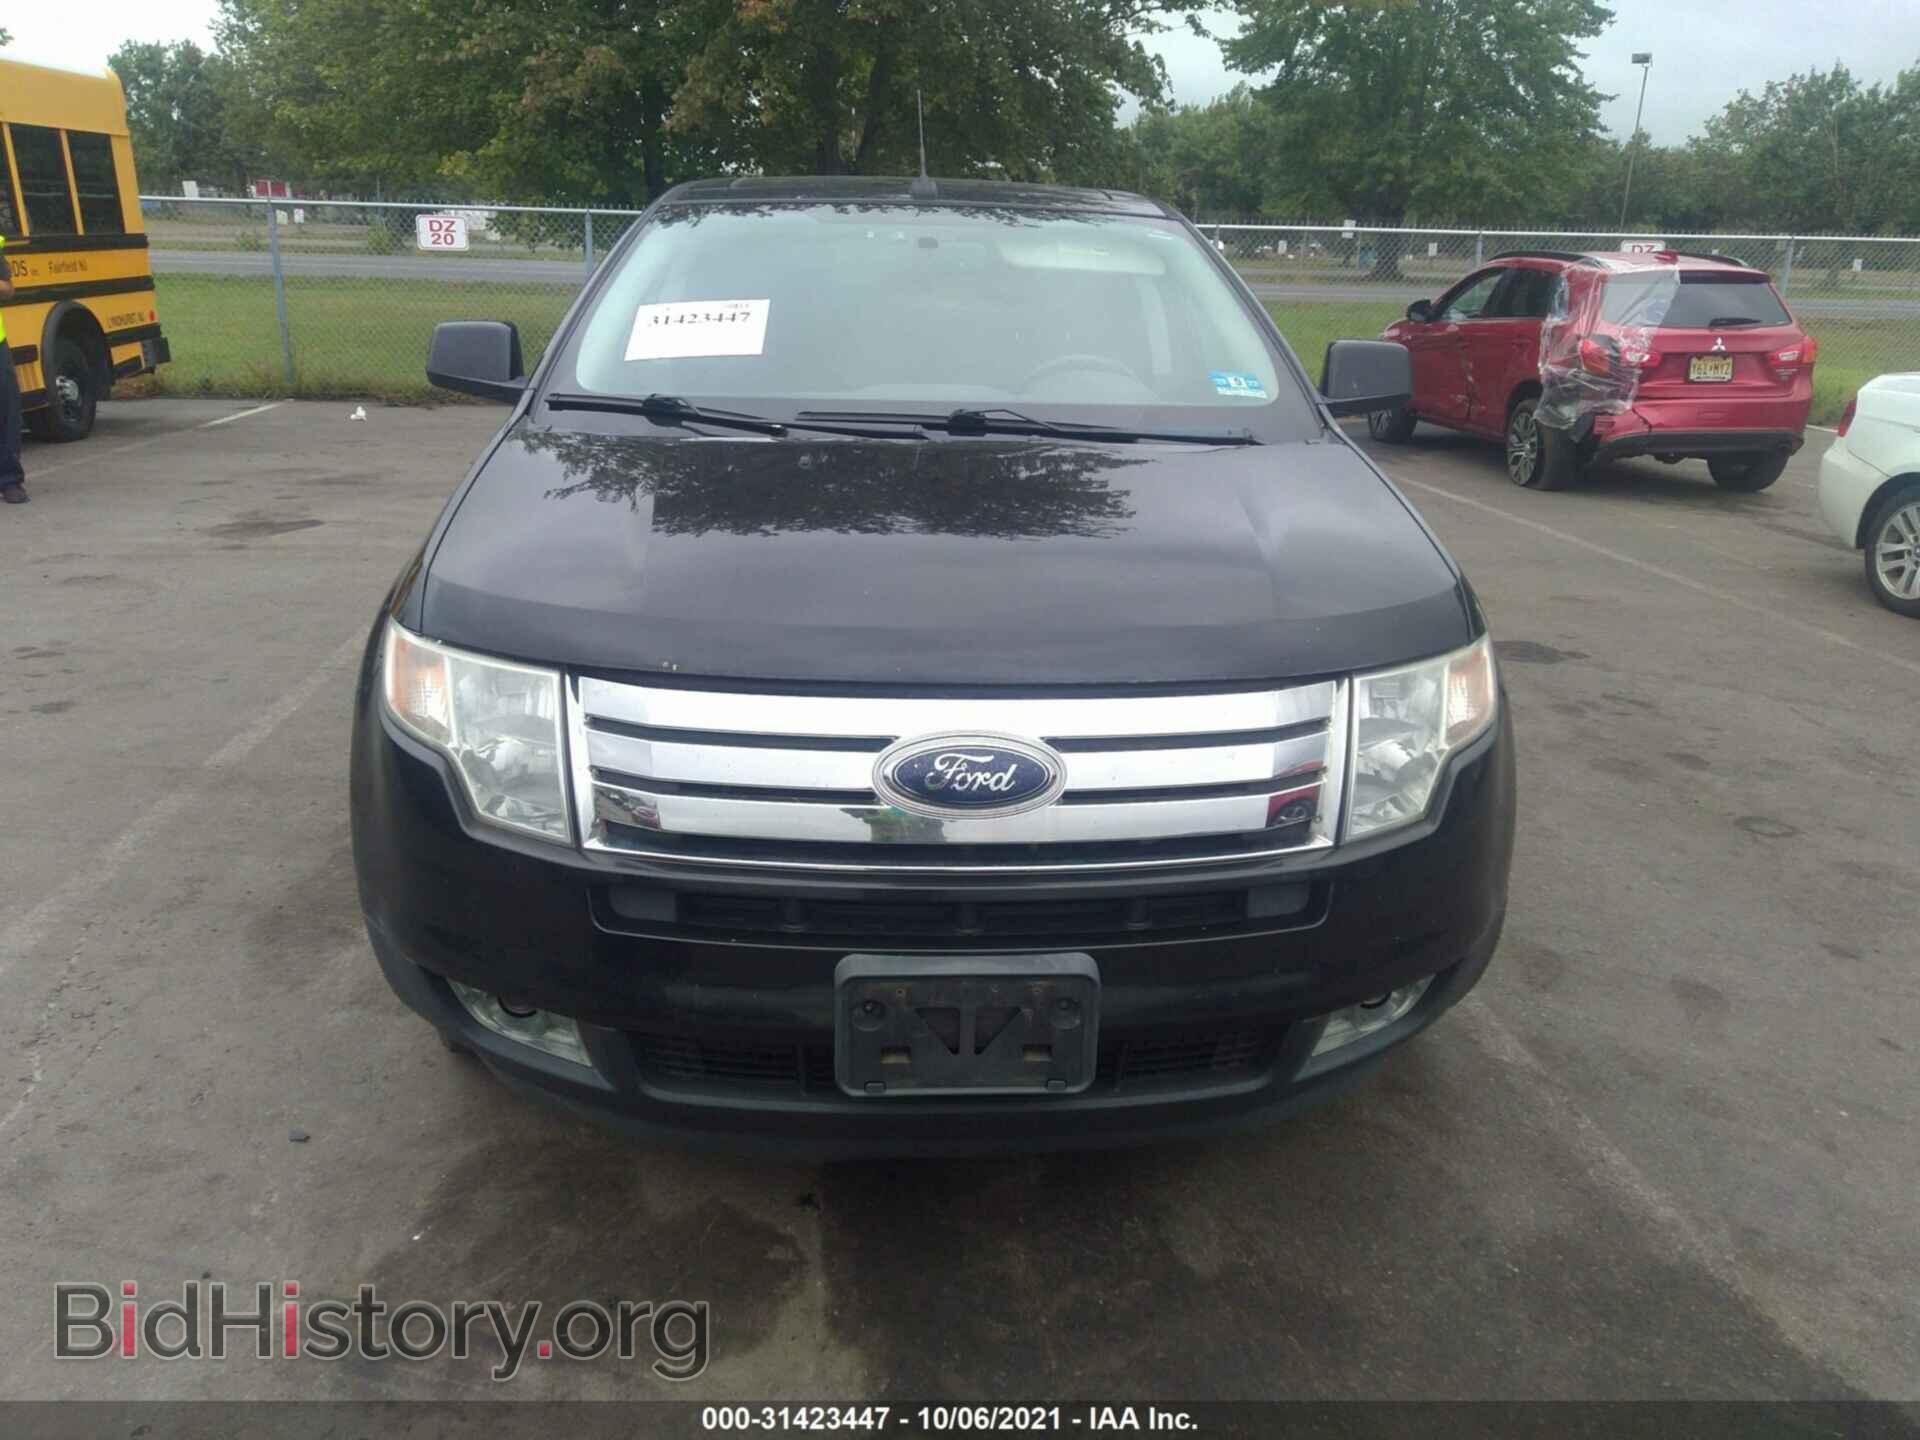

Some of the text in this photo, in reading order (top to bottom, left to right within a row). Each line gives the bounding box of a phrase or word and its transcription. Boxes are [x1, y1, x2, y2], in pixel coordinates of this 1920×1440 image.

[428, 220, 456, 232] DZ
[431, 233, 455, 245] 20
[649, 311, 751, 326] 31423447
[924, 752, 1018, 792] Ford
